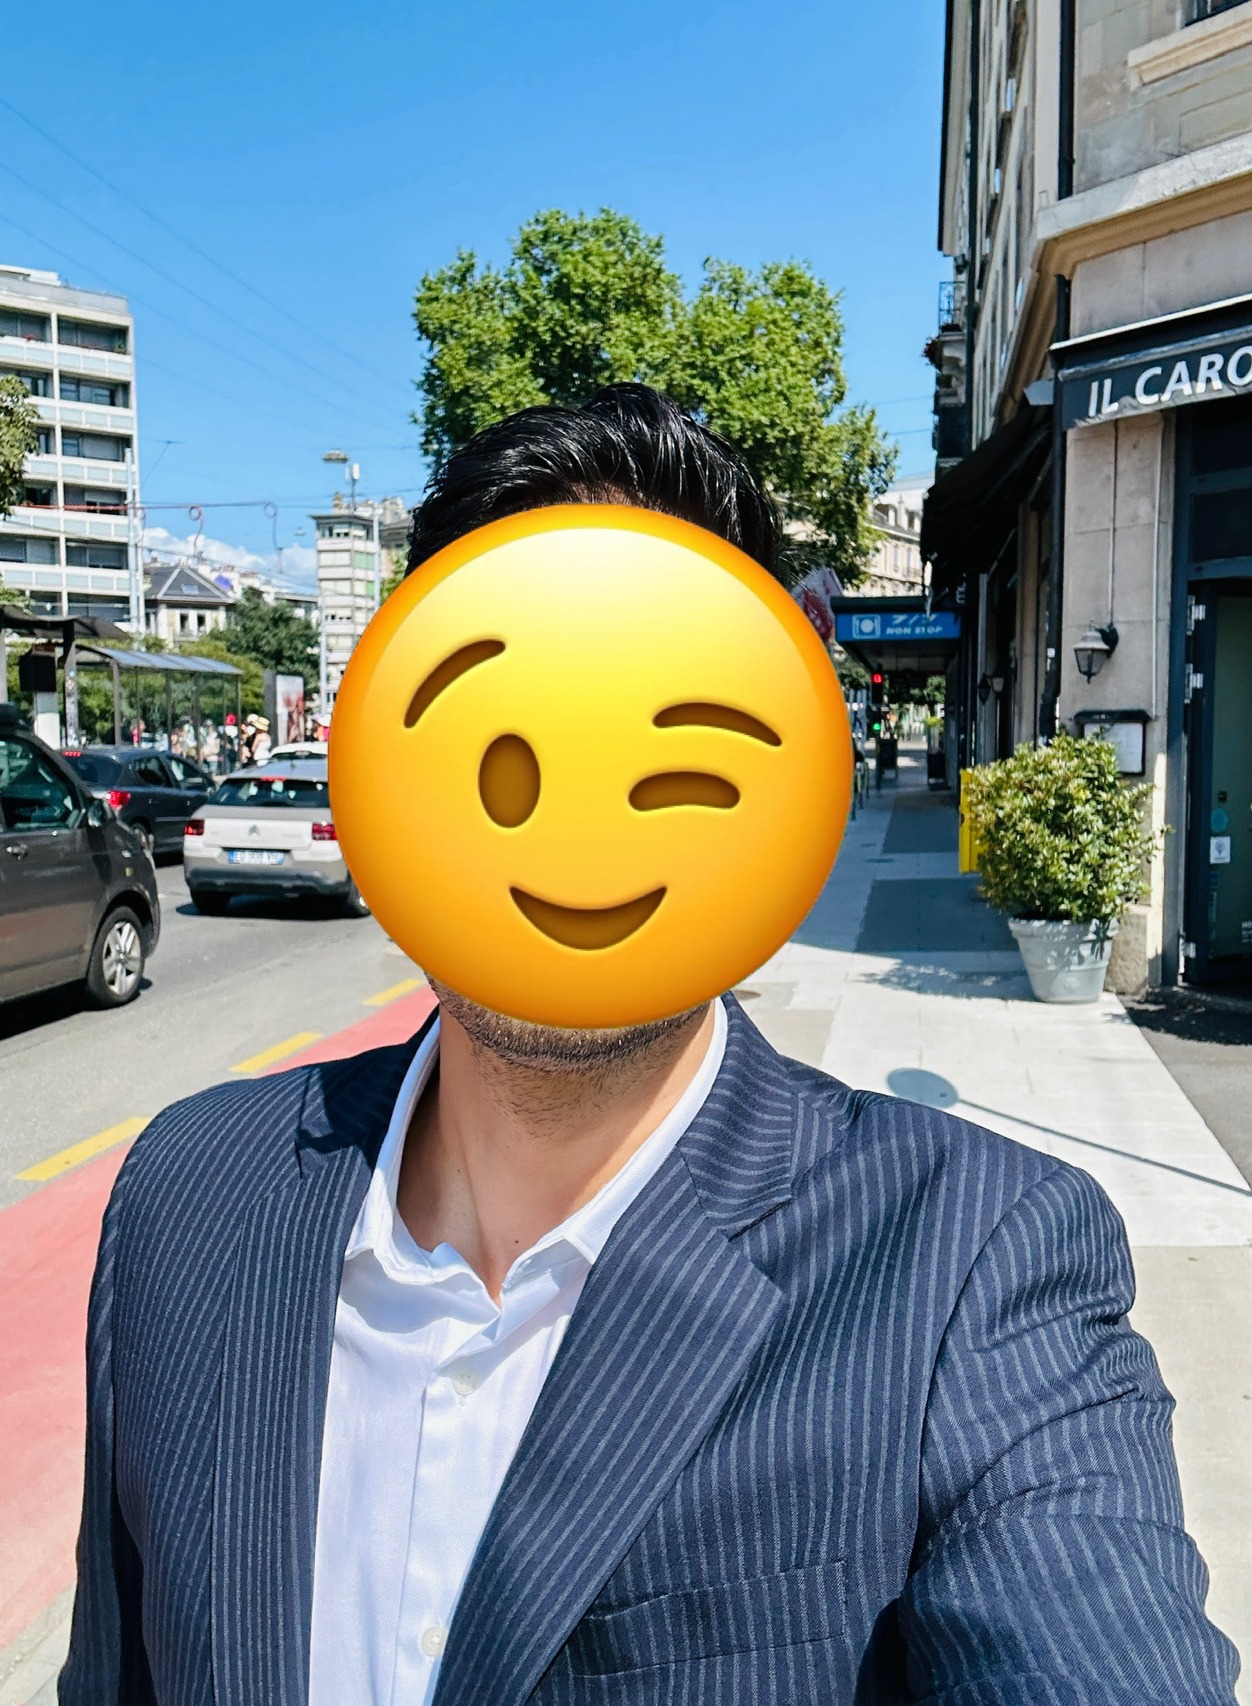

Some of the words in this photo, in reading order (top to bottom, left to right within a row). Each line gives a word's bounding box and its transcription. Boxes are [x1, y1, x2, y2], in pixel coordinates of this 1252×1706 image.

[1088, 377, 1119, 418] IL
[1135, 345, 1252, 406] CARO
[886, 627, 911, 635] NON
[915, 626, 943, 635] STOP
